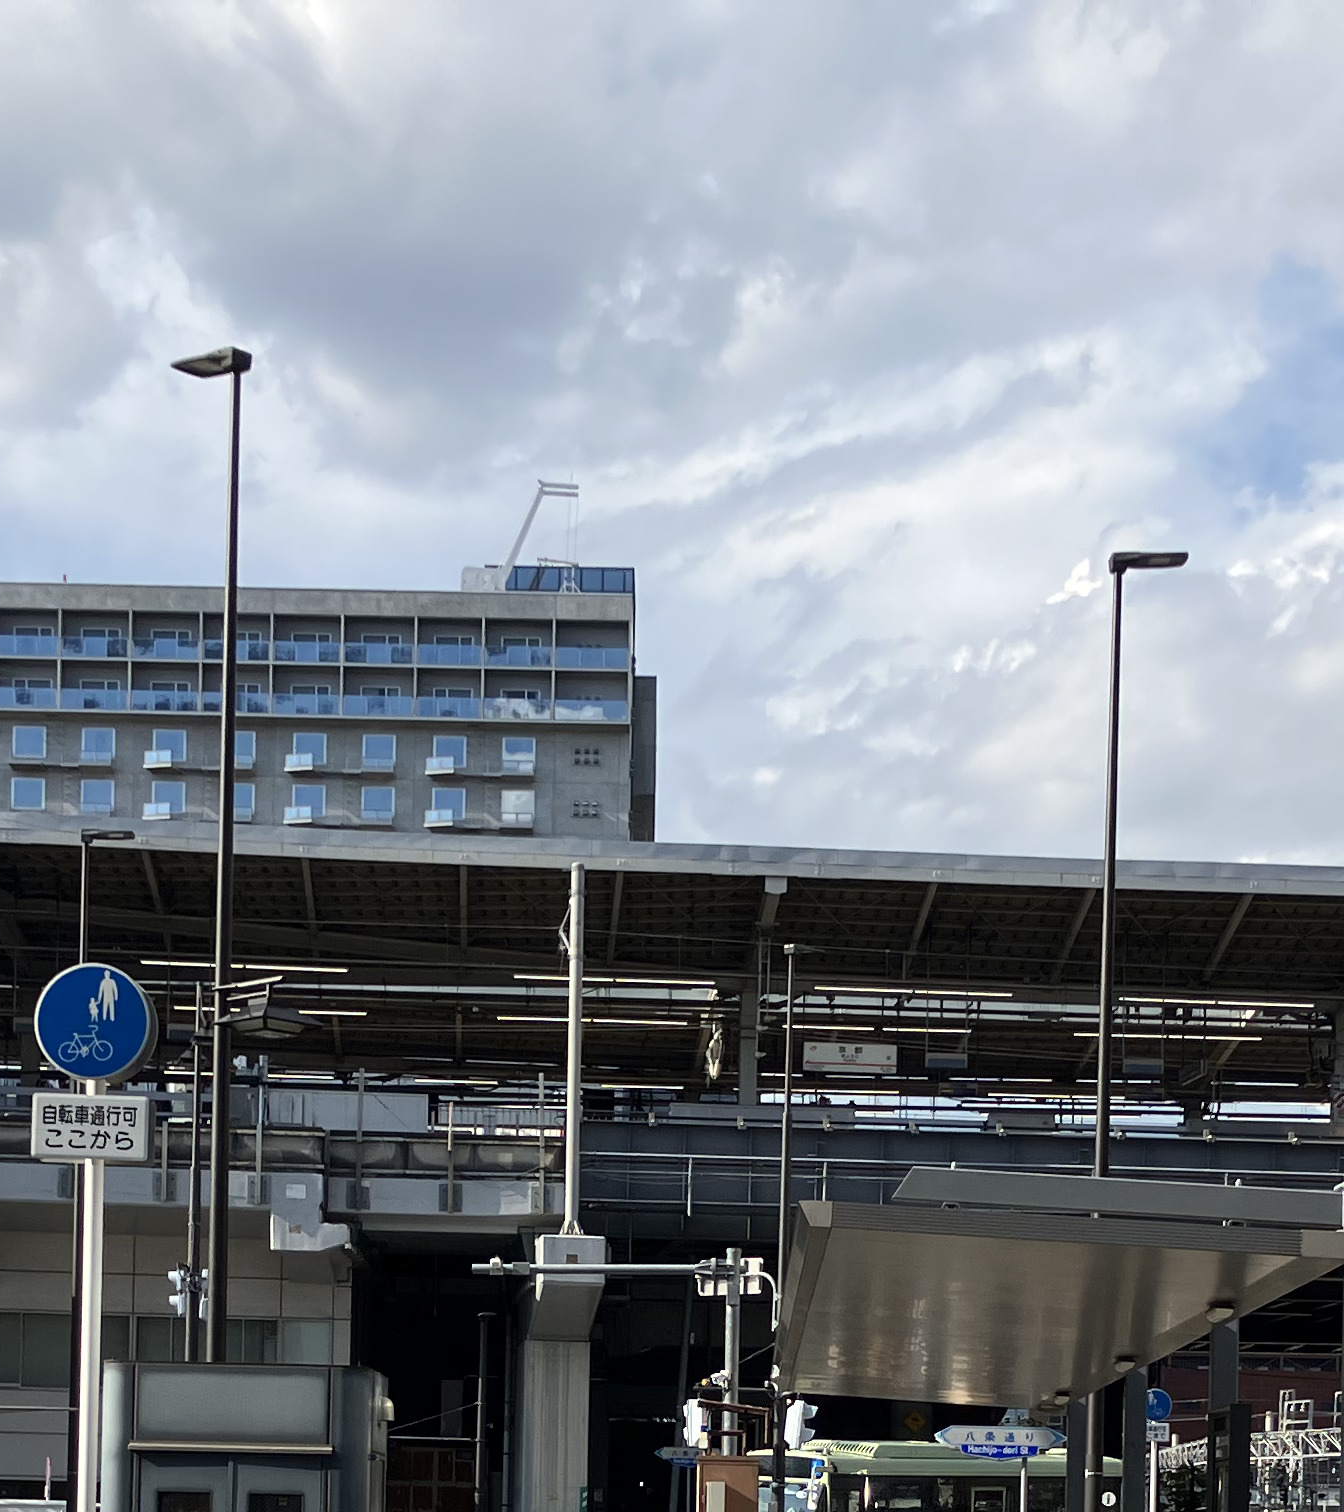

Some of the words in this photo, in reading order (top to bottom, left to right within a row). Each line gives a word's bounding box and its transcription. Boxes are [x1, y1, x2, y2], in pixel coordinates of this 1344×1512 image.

[42, 1104, 138, 1127] 自転車通行可
[45, 1128, 134, 1151] ここから
